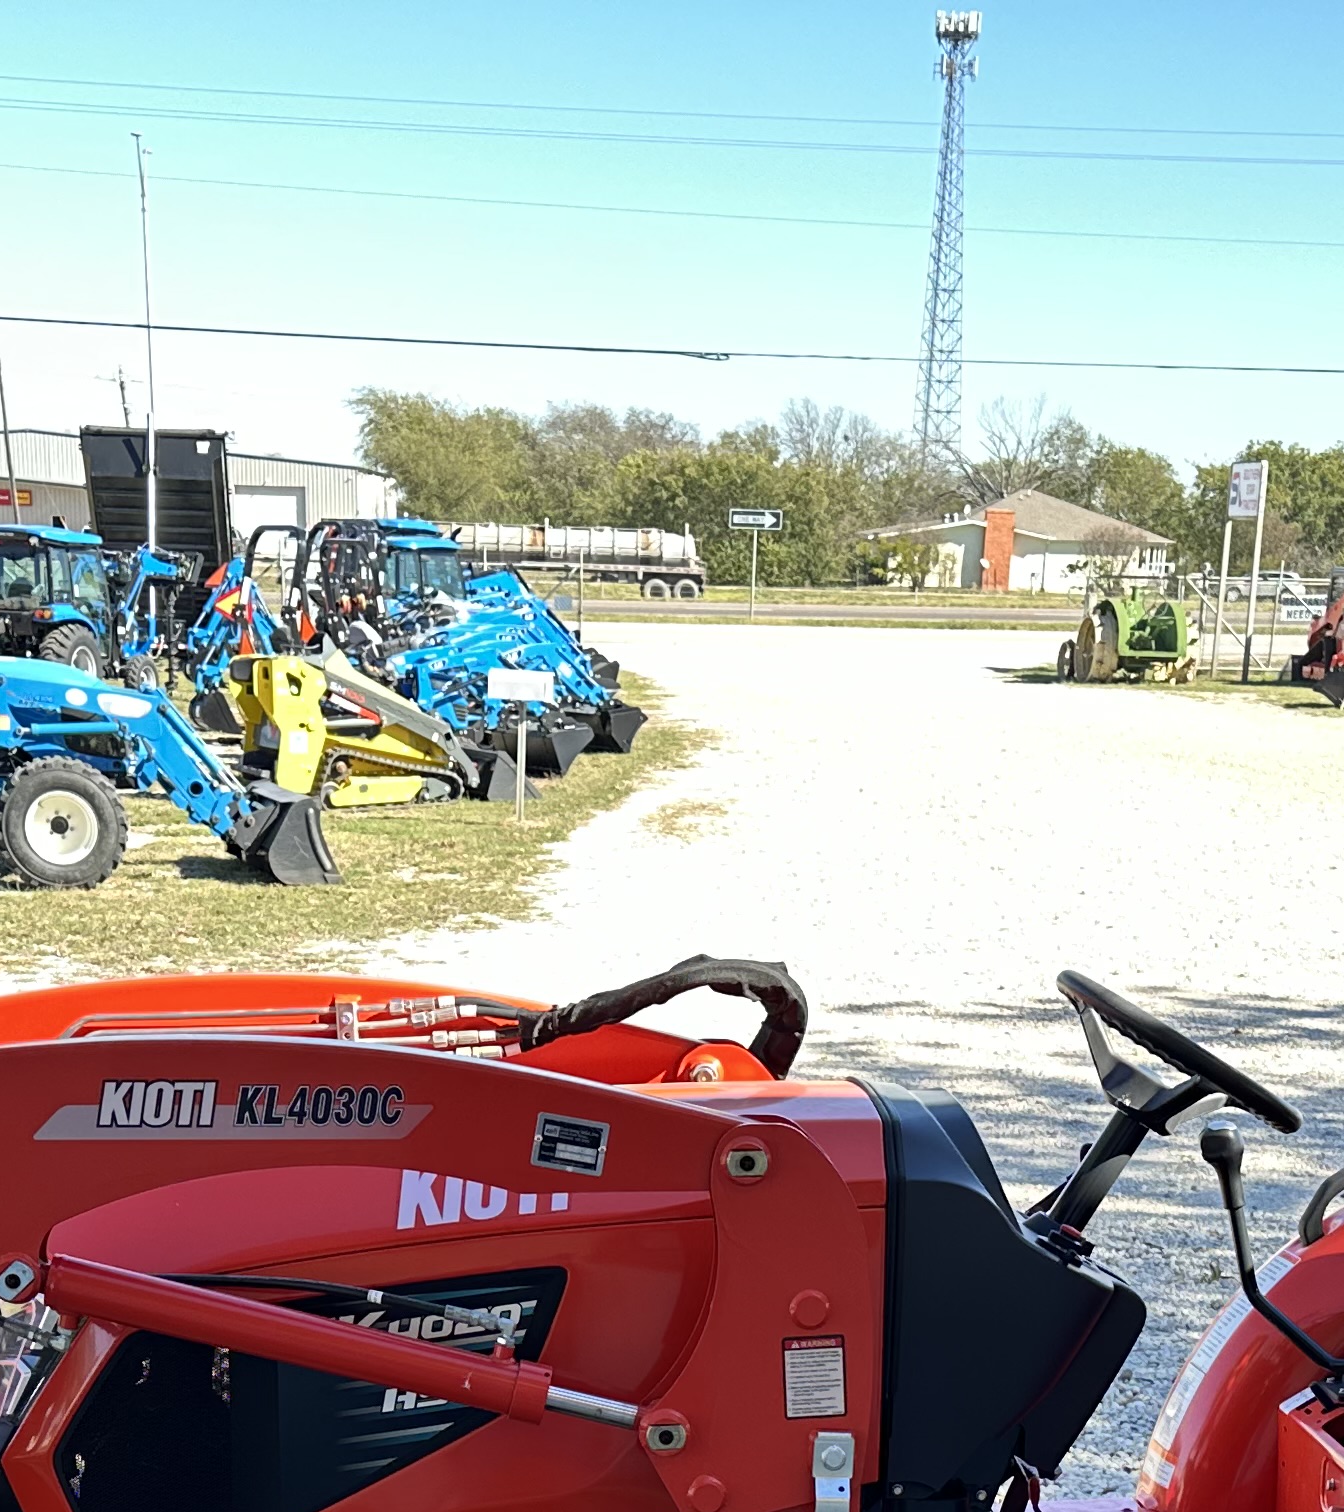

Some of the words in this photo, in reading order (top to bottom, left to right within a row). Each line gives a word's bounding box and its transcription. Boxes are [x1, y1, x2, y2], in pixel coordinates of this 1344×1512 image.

[96, 1079, 218, 1129] KIOTI
[233, 1084, 405, 1128] KL4030C
[800, 1338, 836, 1348] WARNING
